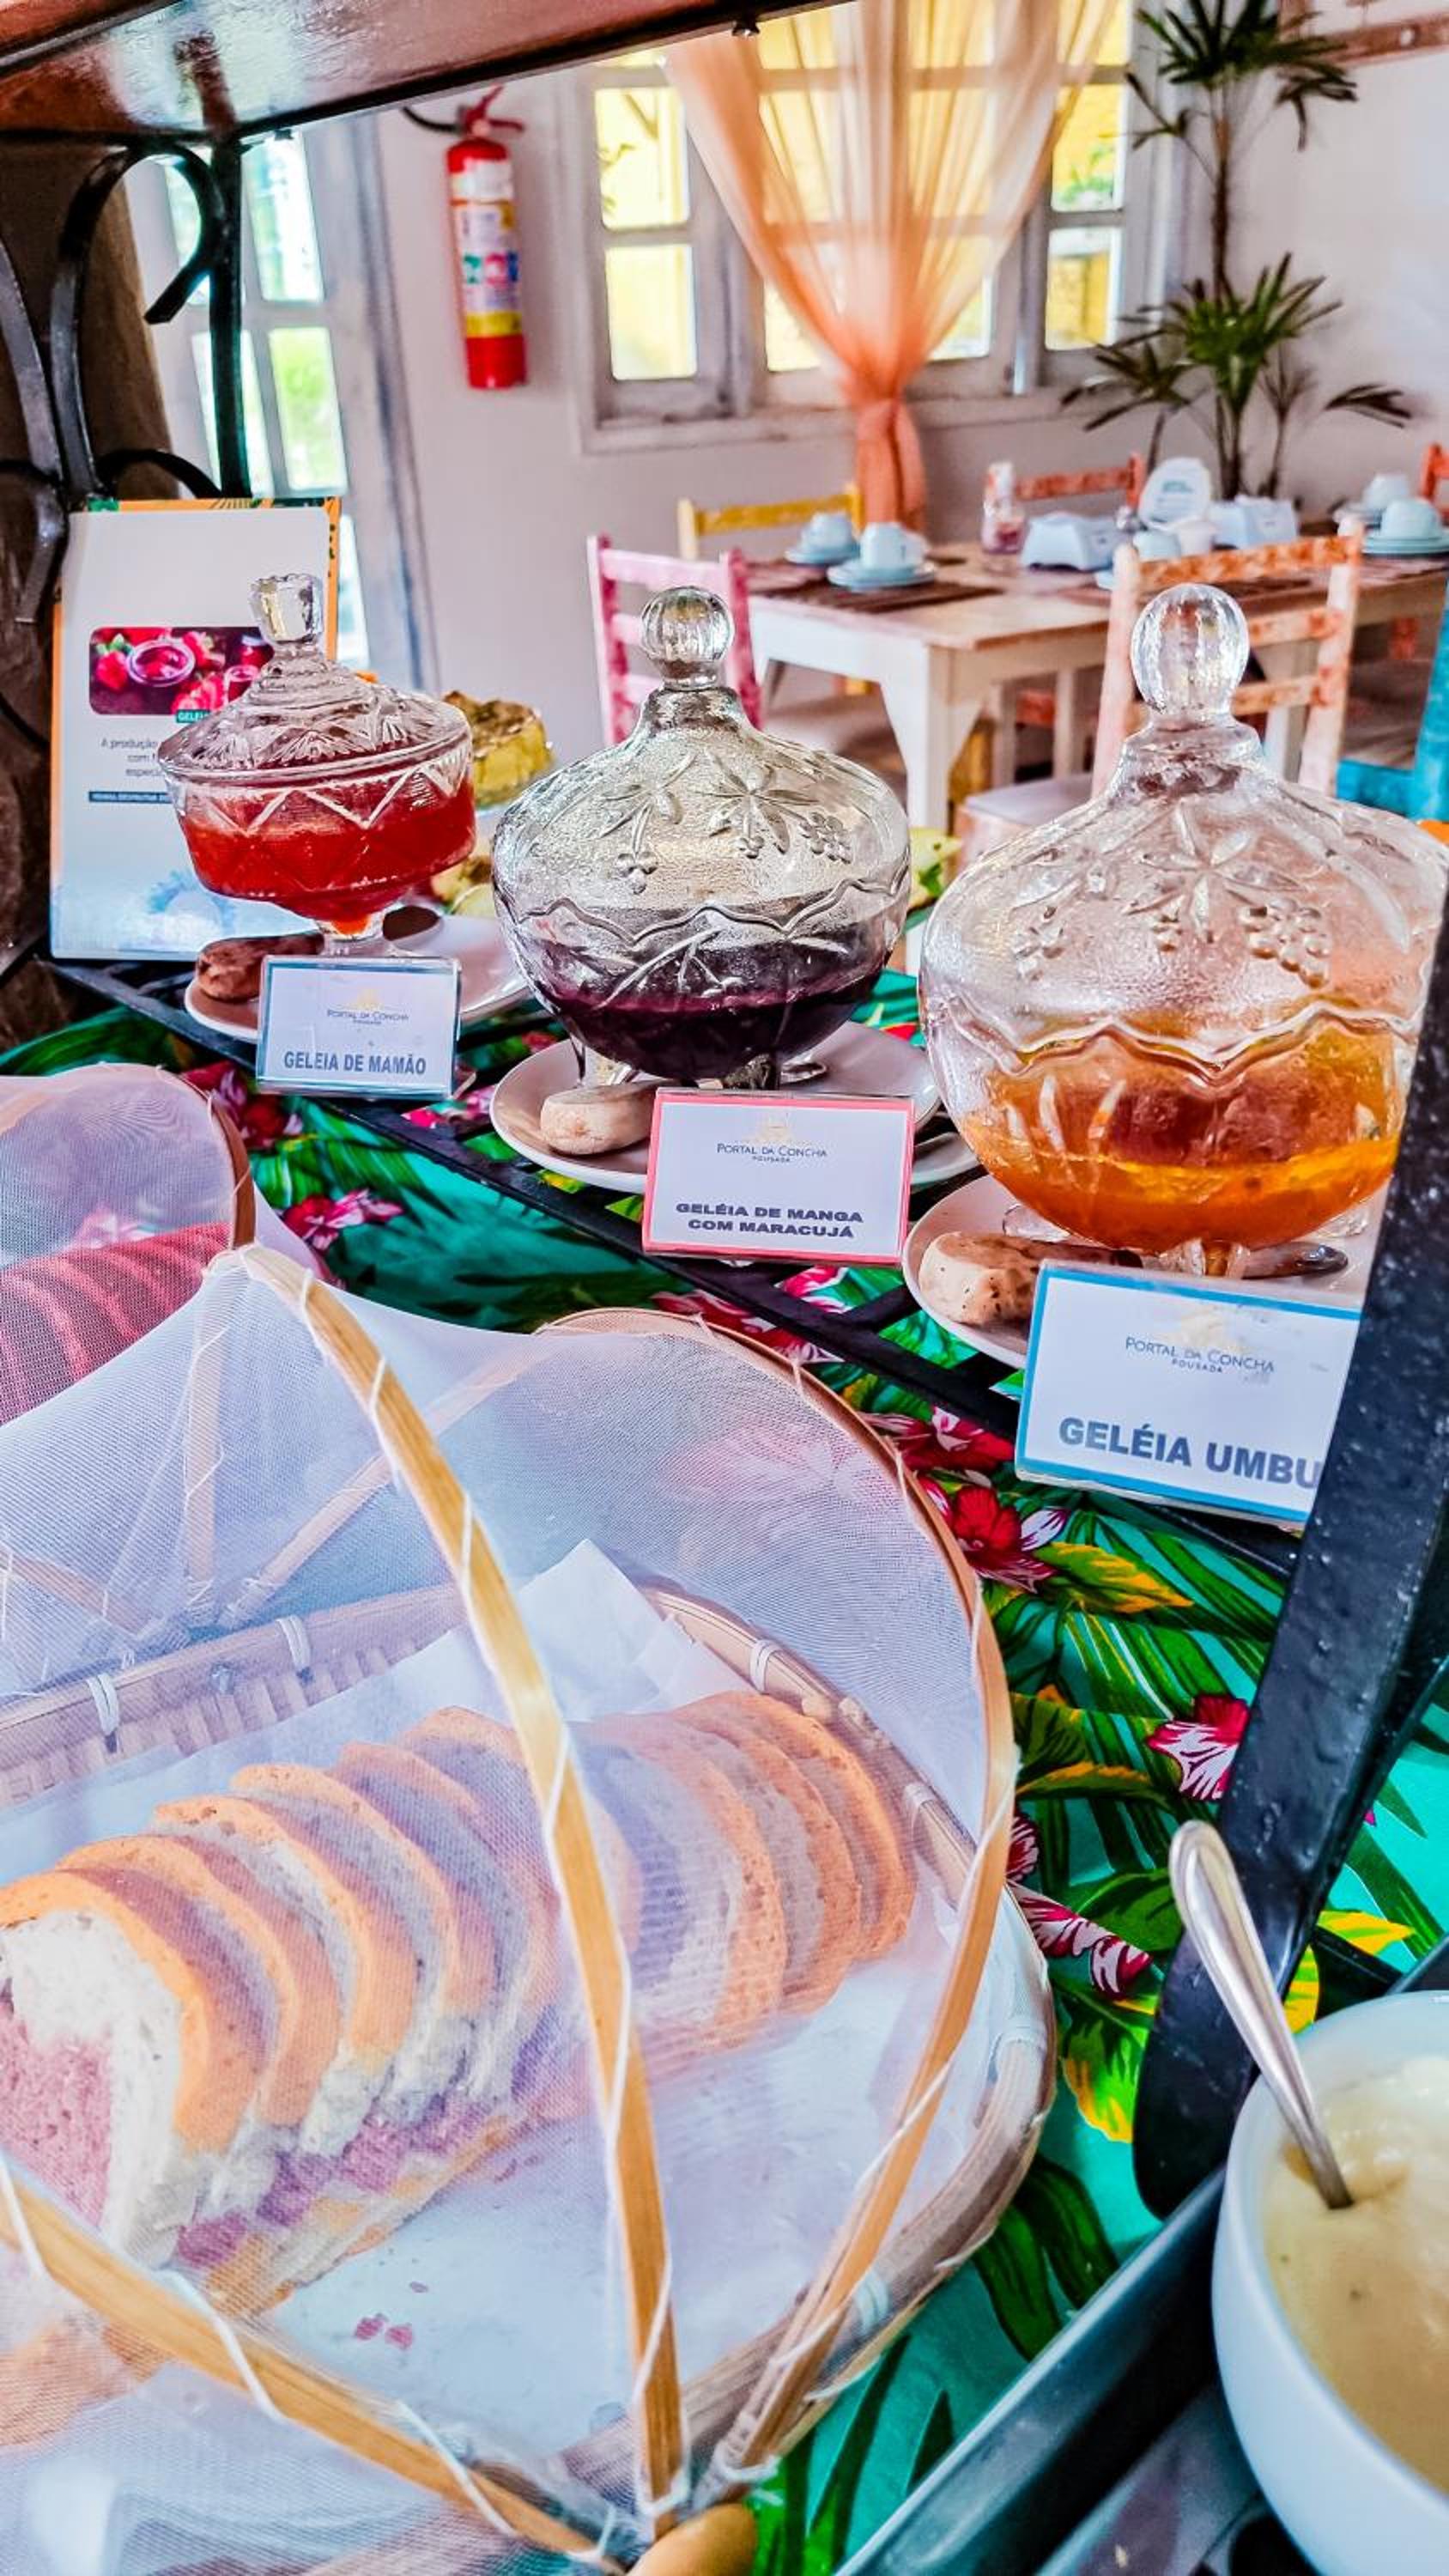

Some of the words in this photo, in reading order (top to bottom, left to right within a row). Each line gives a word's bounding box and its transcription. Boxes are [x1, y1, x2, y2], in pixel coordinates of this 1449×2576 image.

[327, 1009, 356, 1019] PORTAL
[373, 1011, 409, 1022] CONCHA
[284, 1051, 338, 1071] GELEIA
[344, 1054, 364, 1072] DE
[368, 1054, 427, 1076] MAMÃO
[717, 1143, 757, 1155] PORTAL
[761, 1146, 774, 1156] DA
[778, 1145, 828, 1157] CONCHA
[676, 1203, 749, 1218] GELÉIA
[755, 1206, 781, 1218] DE
[787, 1208, 864, 1224] MANGA
[688, 1218, 733, 1231] COM
[739, 1222, 854, 1238] MARACUJÁ
[1125, 1336, 1179, 1357] PORTAL
[1184, 1348, 1202, 1359] DA
[1208, 1349, 1275, 1373] CONCHA
[1172, 1358, 1223, 1373] POUSADA
[1058, 1417, 1191, 1467] GELÉIA
[1205, 1442, 1321, 1489] UMBU
